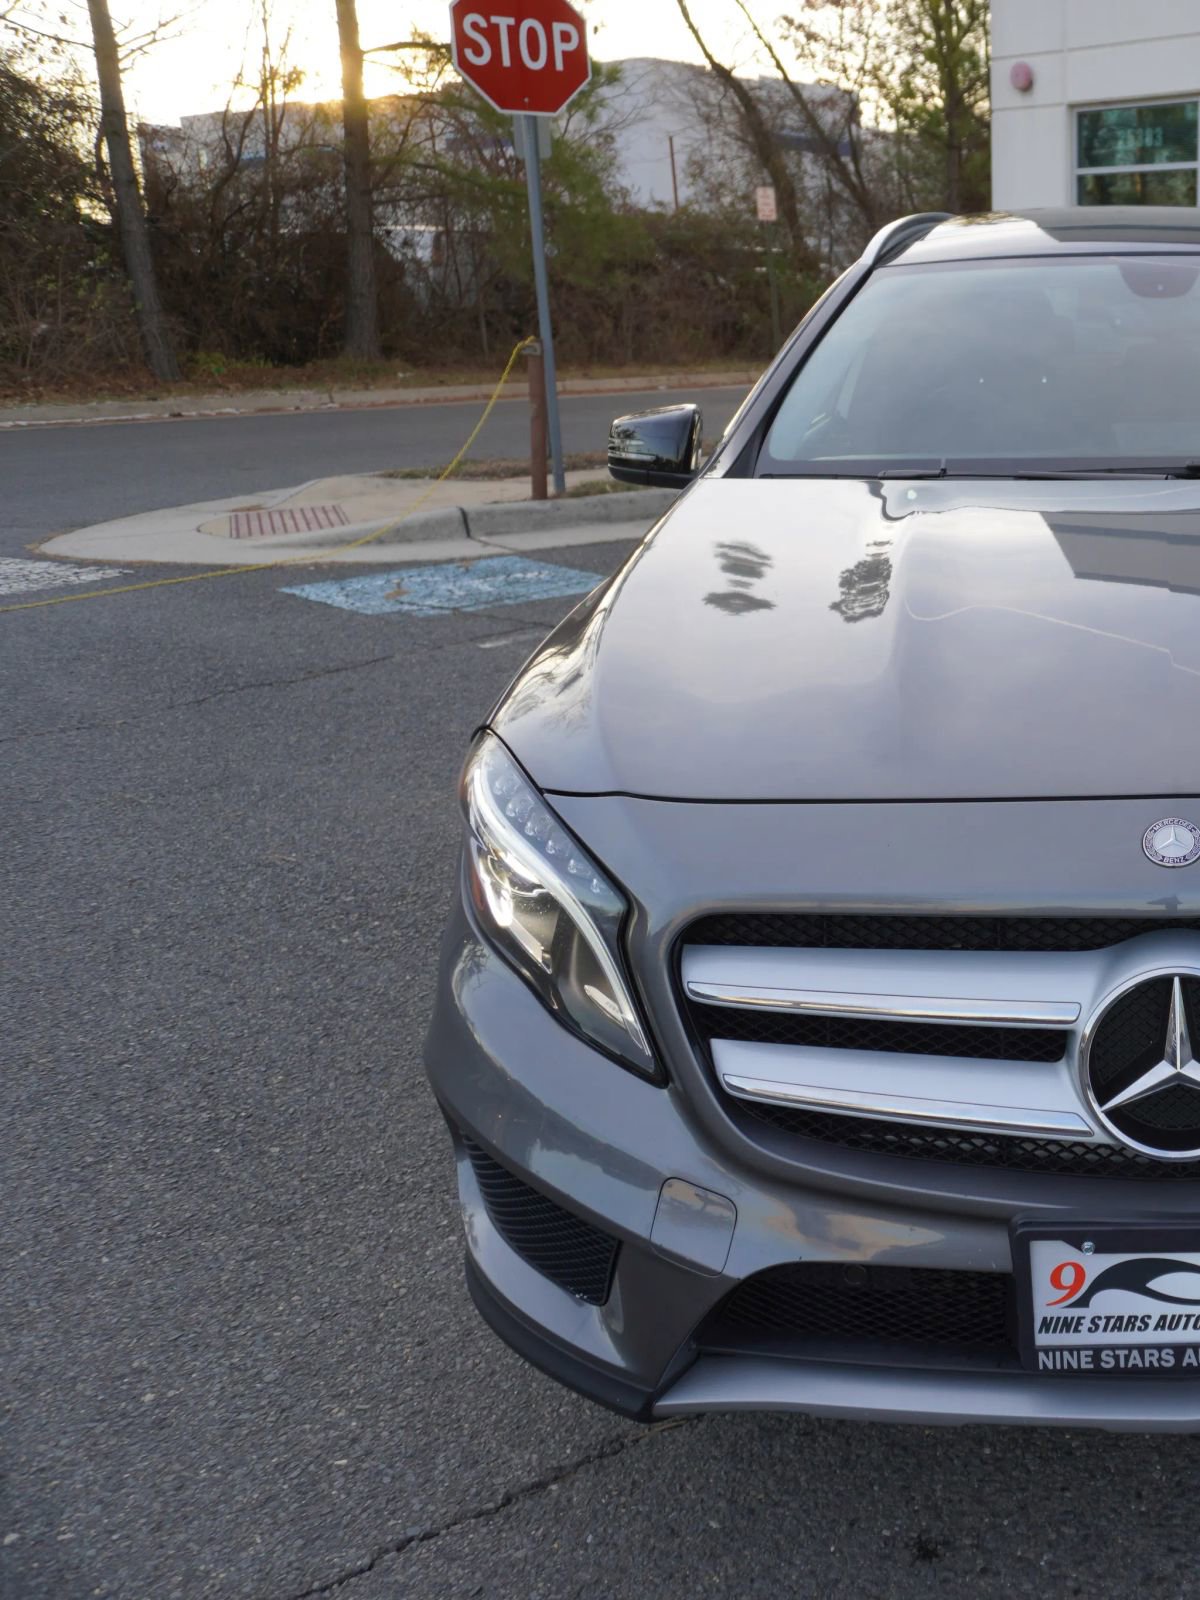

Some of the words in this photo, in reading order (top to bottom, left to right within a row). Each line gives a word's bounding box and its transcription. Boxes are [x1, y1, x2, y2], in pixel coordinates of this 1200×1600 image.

[462, 13, 579, 72] STOP
[1046, 1261, 1087, 1307] 9
[1037, 1315, 1086, 1335] NINE
[1087, 1313, 1153, 1334] STARS
[1038, 1350, 1094, 1371] NINE
[1100, 1348, 1176, 1370] STARS
